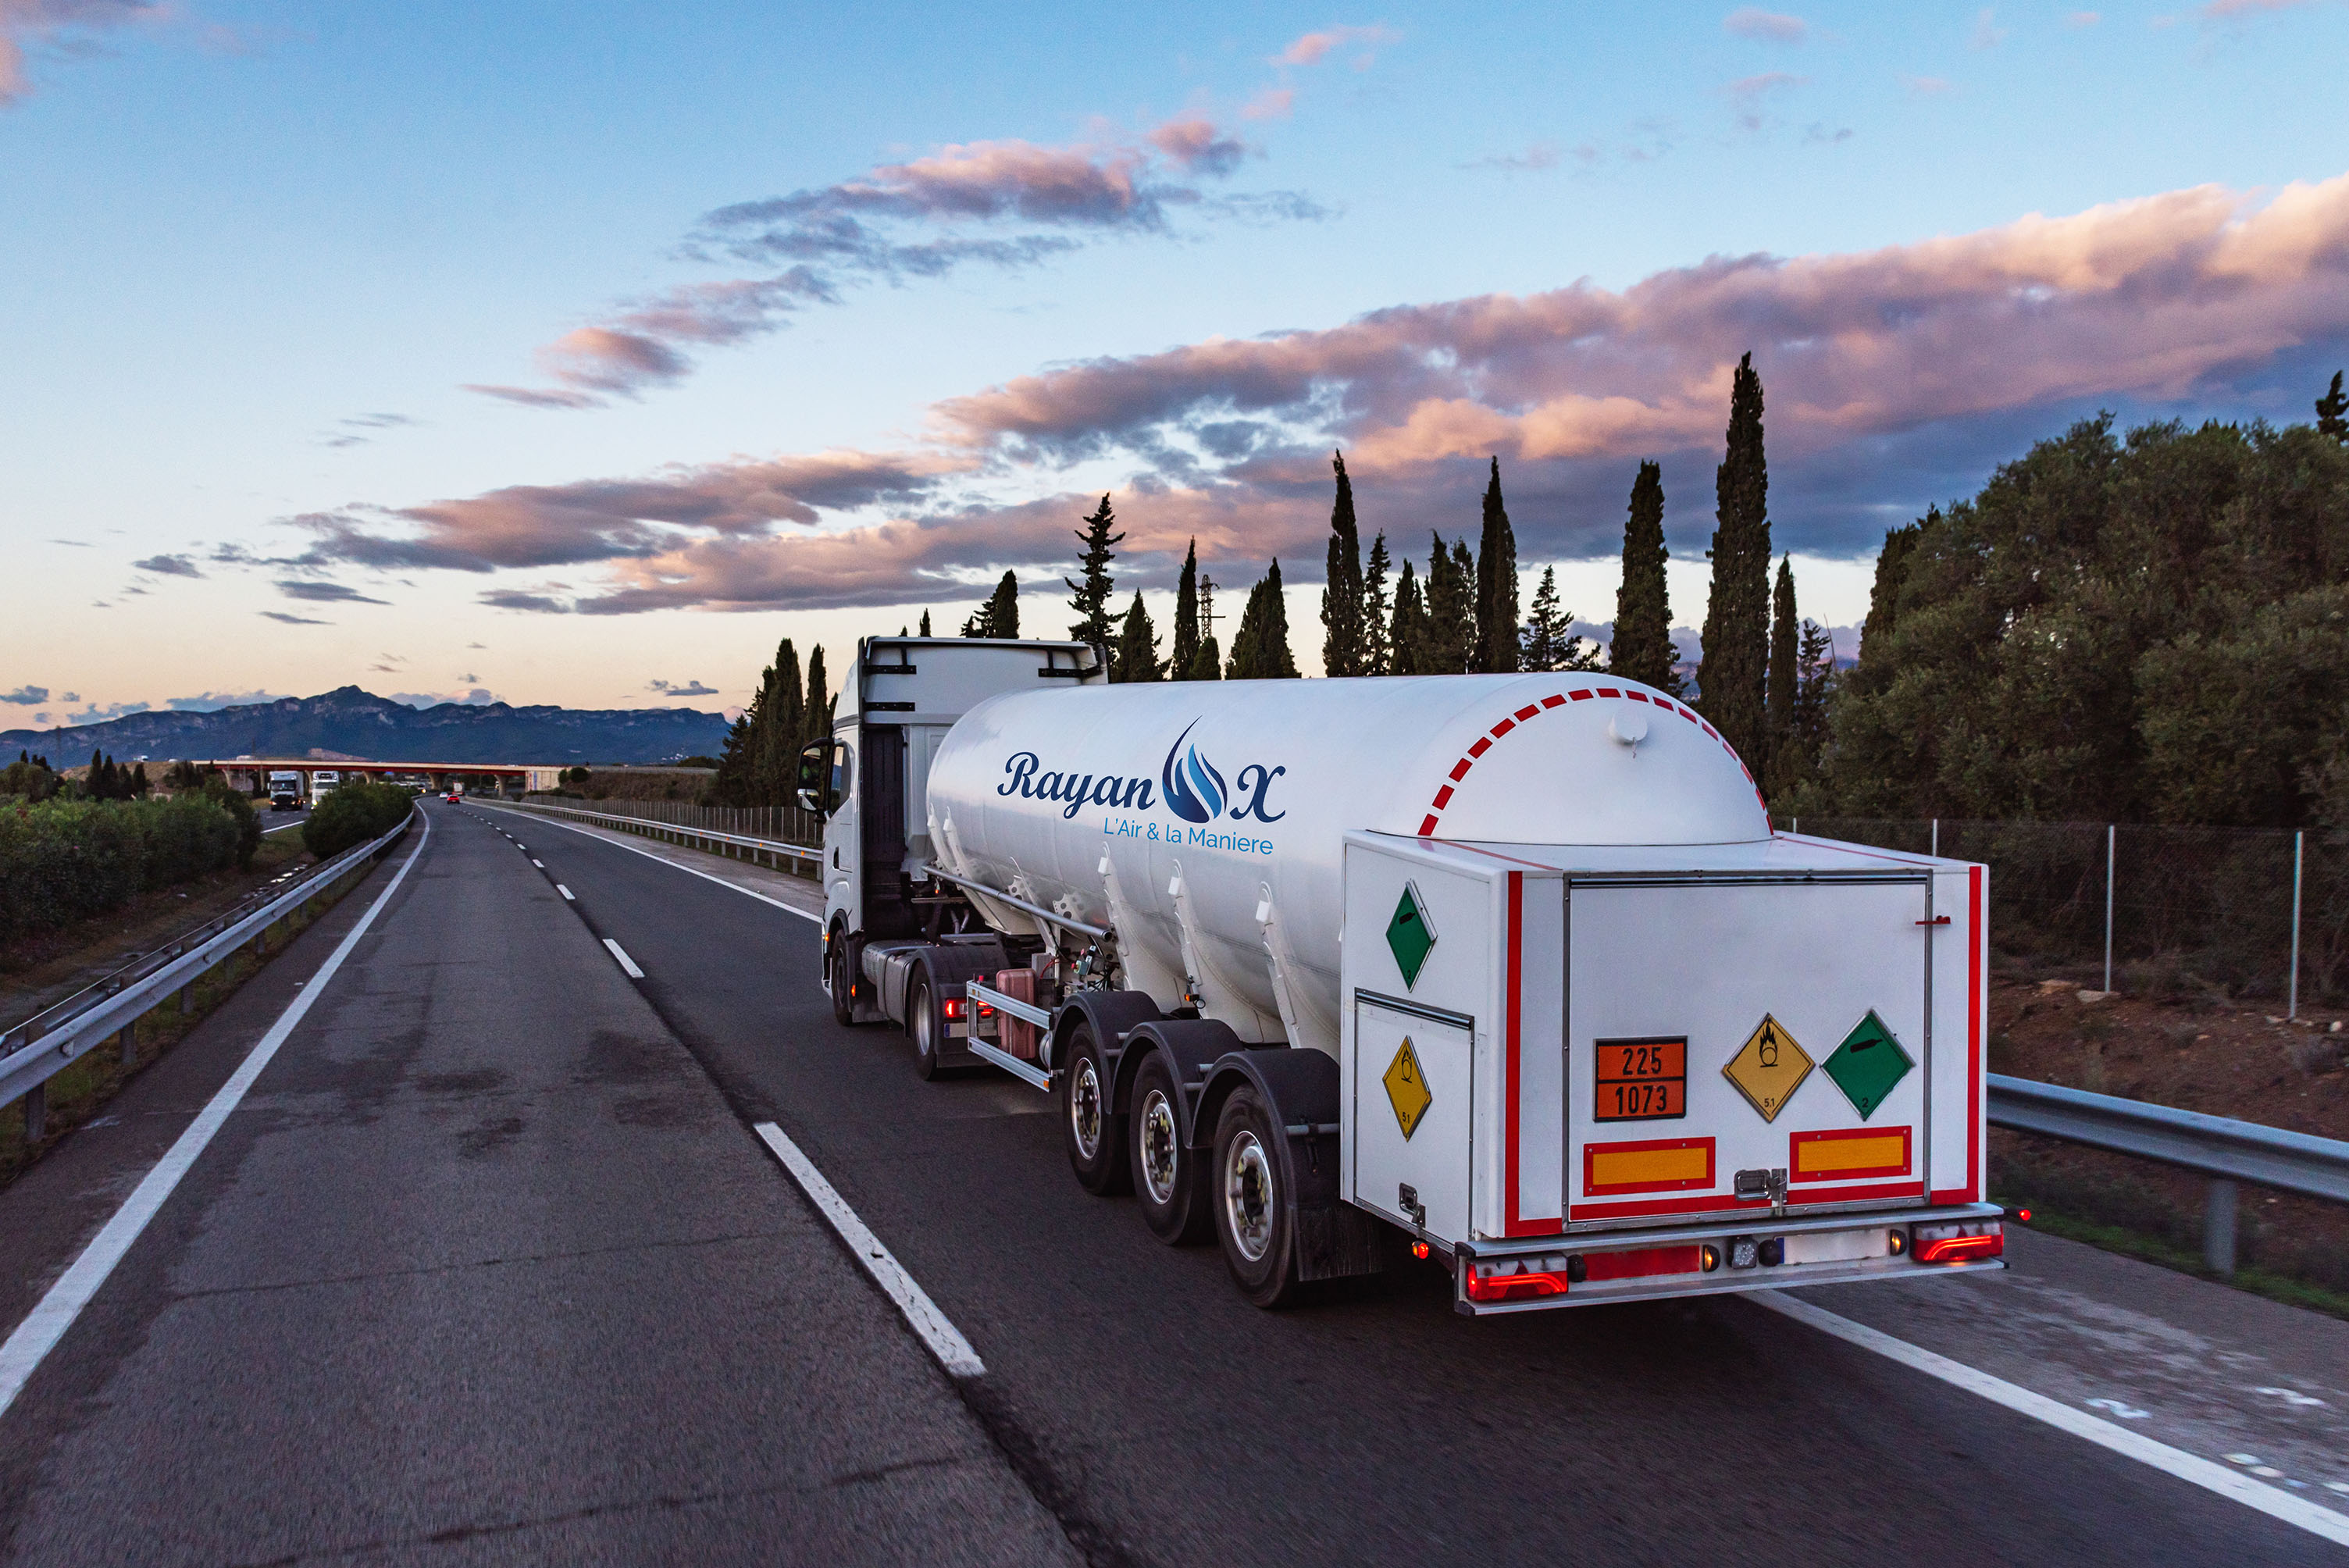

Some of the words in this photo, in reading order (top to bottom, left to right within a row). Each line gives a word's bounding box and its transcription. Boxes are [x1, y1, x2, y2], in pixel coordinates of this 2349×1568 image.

[997, 751, 1155, 819] Rayan
[1103, 818, 1142, 838] L'Air
[1146, 822, 1160, 842] &
[1166, 824, 1182, 844] la
[1189, 827, 1274, 855] Maniere
[1407, 969, 1412, 980] 2
[1622, 1046, 1662, 1075] 225
[1615, 1085, 1667, 1115] 1073
[1764, 1097, 1775, 1107] 5.1
[1862, 1096, 1869, 1108] 2
